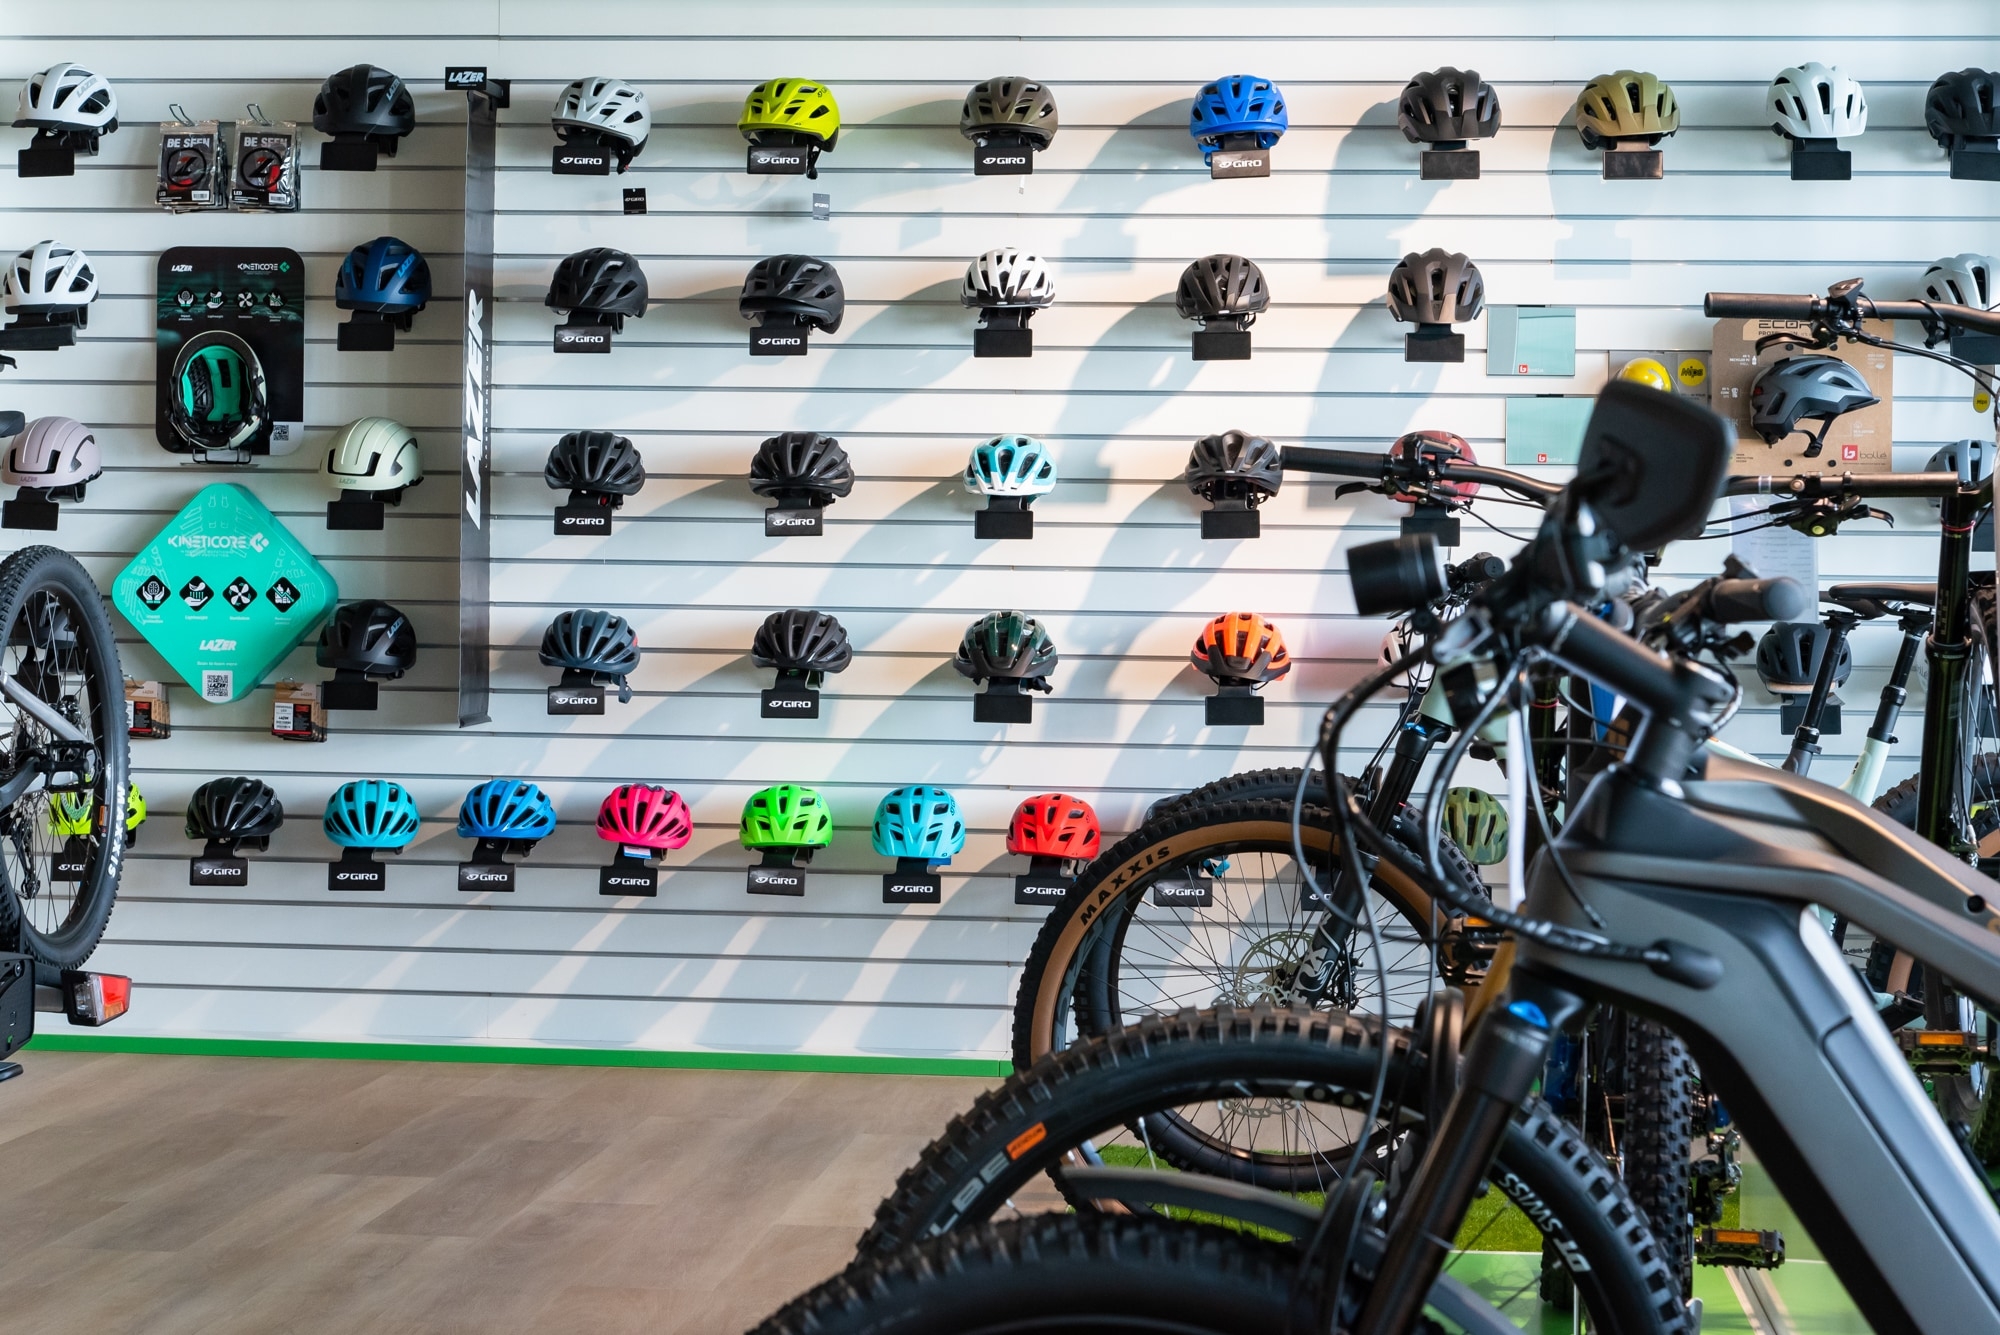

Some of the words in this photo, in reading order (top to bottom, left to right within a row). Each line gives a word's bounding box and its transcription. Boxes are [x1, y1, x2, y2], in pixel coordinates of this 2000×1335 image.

[448, 71, 484, 84] LAZER
[167, 138, 181, 148] BE
[244, 136, 258, 147] BE
[574, 157, 602, 165] GIRO
[997, 157, 1026, 165] GIRO
[1232, 160, 1262, 168] GIRO
[171, 264, 193, 272] LAZER
[237, 263, 279, 271] KINETICORE
[575, 335, 604, 343] GIRO
[466, 289, 483, 530] LAZER
[787, 518, 816, 526] GIRO
[167, 535, 247, 549] KINETICORE
[199, 639, 237, 652] LAZER
[569, 697, 598, 705] GIRO
[782, 700, 811, 708] GIRO
[108, 782, 126, 878] MAXXIS
[213, 868, 241, 876] GIRO
[350, 873, 378, 881] GIRO
[480, 873, 508, 881] GIRO
[769, 877, 798, 885] GIRO
[621, 878, 650, 886] GIRO
[1080, 846, 1171, 925] MAXXIS
[905, 885, 933, 893] GIRO
[1037, 887, 1066, 896] GIRO
[1175, 888, 1205, 896] GIRO
[1498, 1173, 1563, 1232] SWISS
[1553, 1238, 1591, 1272] DT
